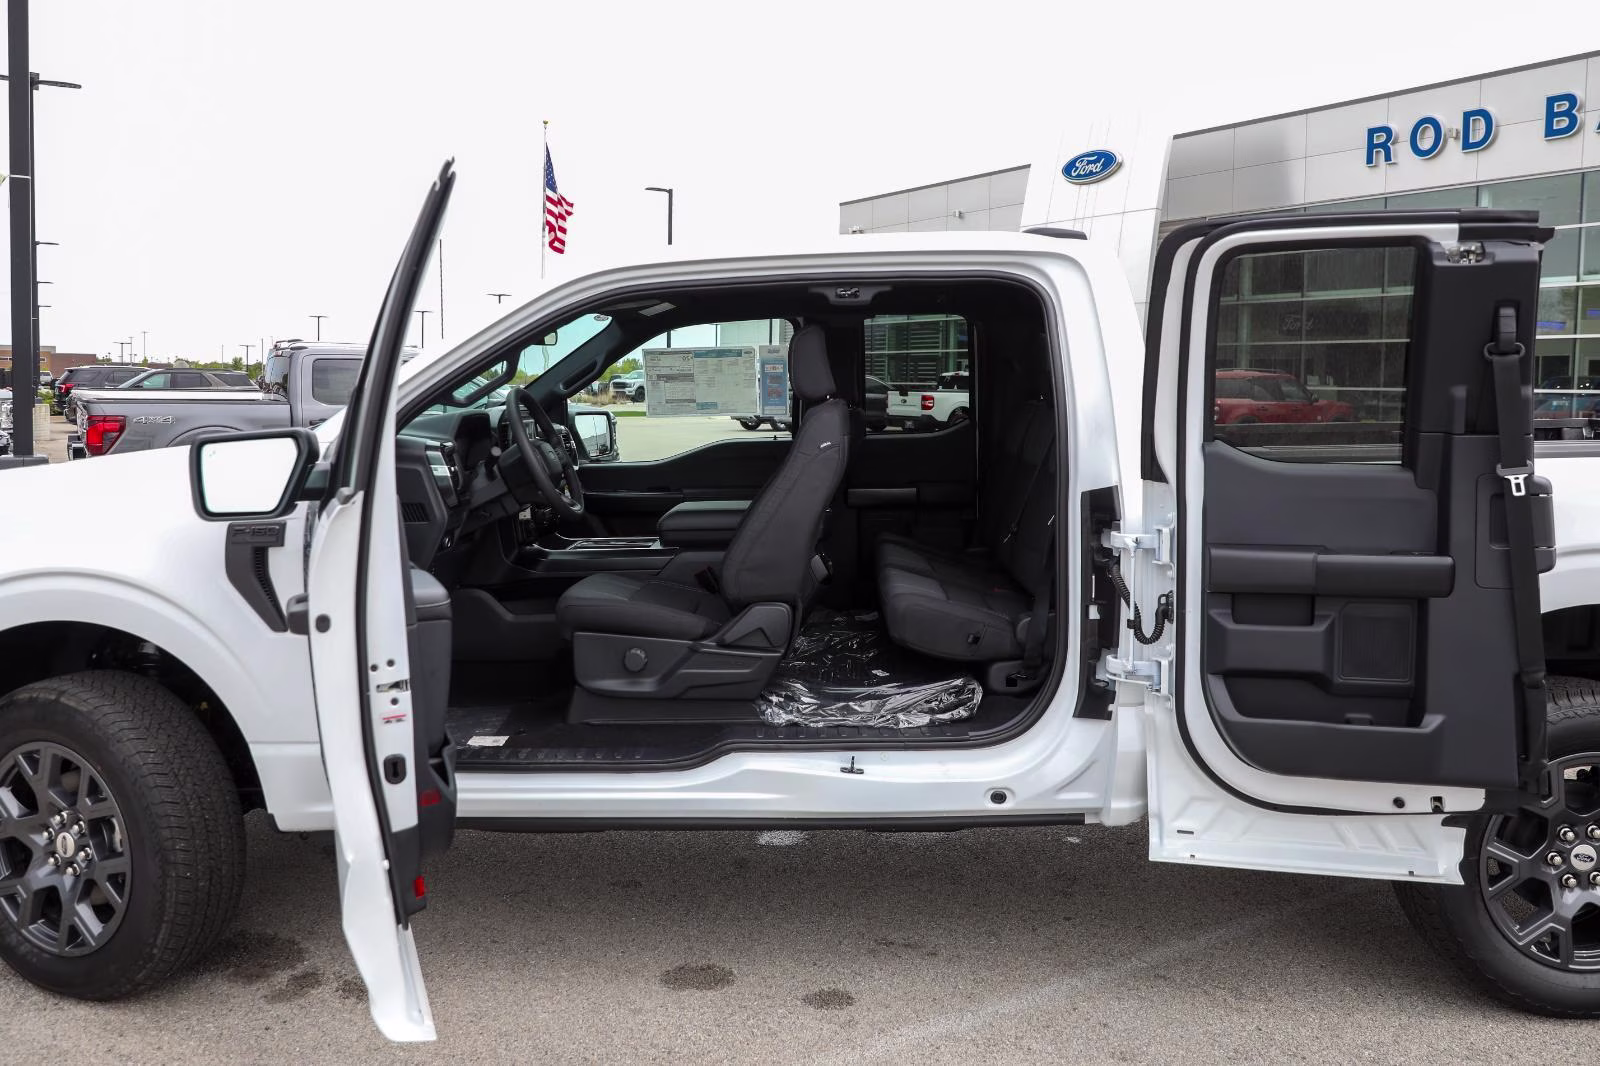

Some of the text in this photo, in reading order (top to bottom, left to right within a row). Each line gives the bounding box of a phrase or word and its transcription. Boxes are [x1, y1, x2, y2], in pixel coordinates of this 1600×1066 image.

[1365, 90, 1600, 167] ROD B
[1071, 155, 1105, 177] Ford
